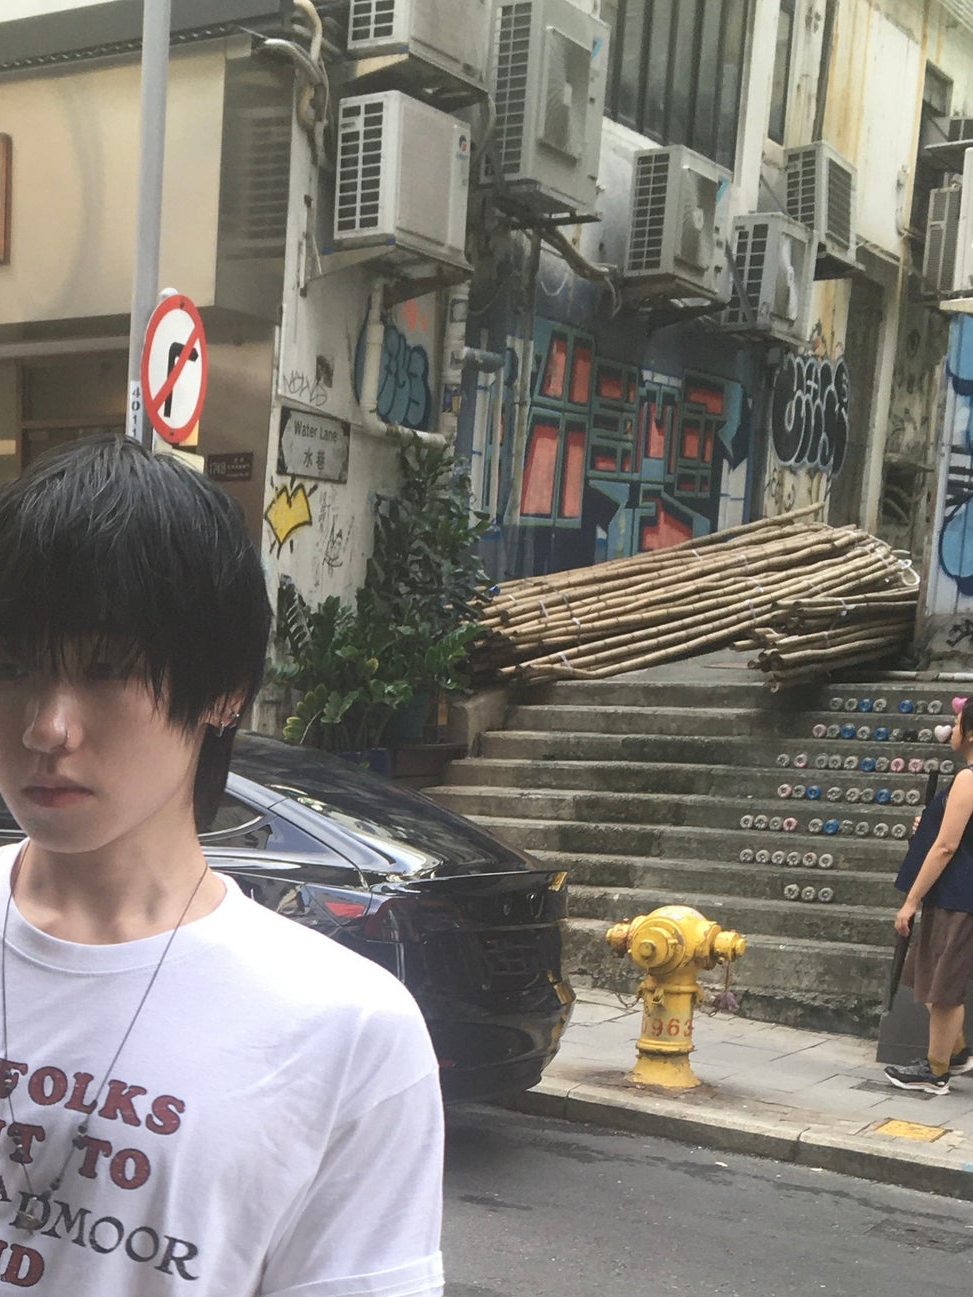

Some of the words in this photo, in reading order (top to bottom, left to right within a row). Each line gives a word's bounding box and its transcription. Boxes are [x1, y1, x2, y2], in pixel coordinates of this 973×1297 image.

[294, 420, 318, 438] Water
[320, 425, 338, 442] Lane
[303, 447, 325, 470] 水巷
[78, 1134, 151, 1190] TO
